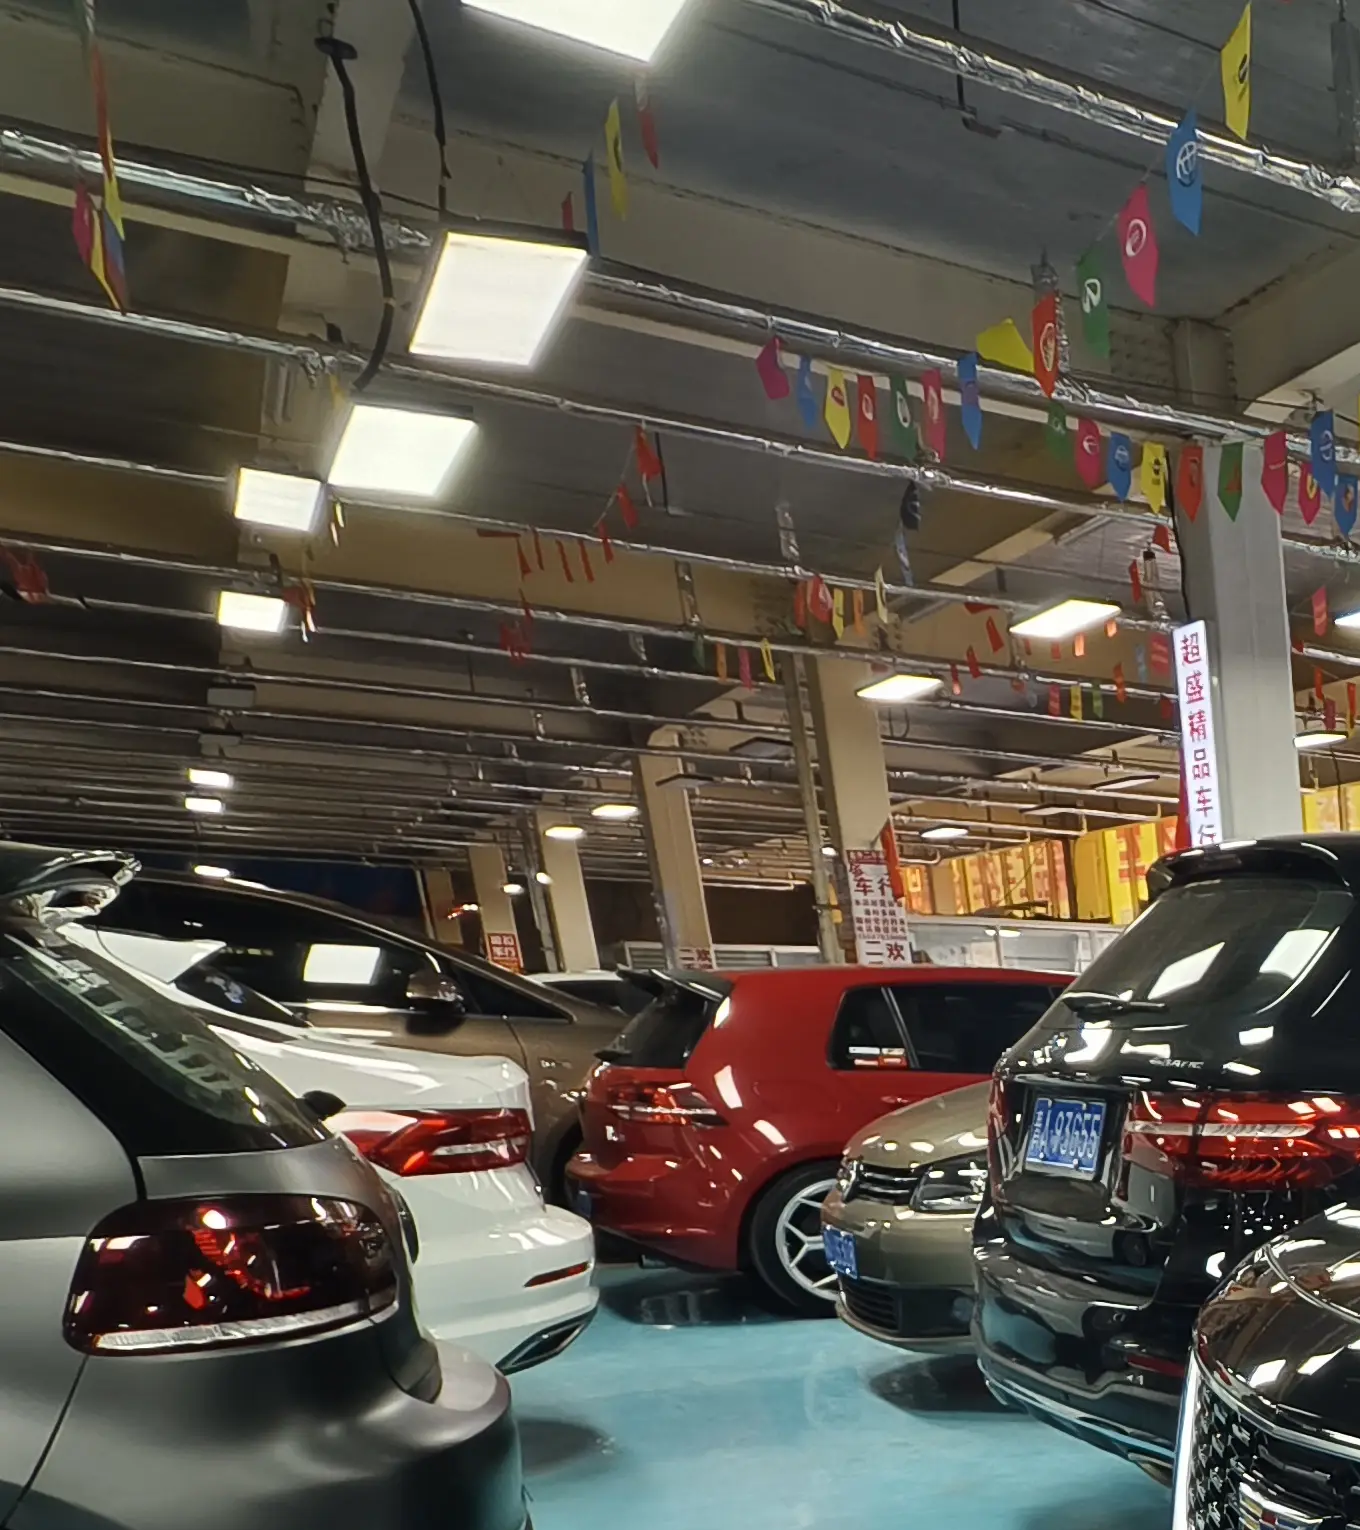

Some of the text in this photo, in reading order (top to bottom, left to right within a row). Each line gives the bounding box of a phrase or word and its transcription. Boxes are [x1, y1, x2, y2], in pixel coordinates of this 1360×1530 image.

[1180, 632, 1217, 846] 超盛精品车行
